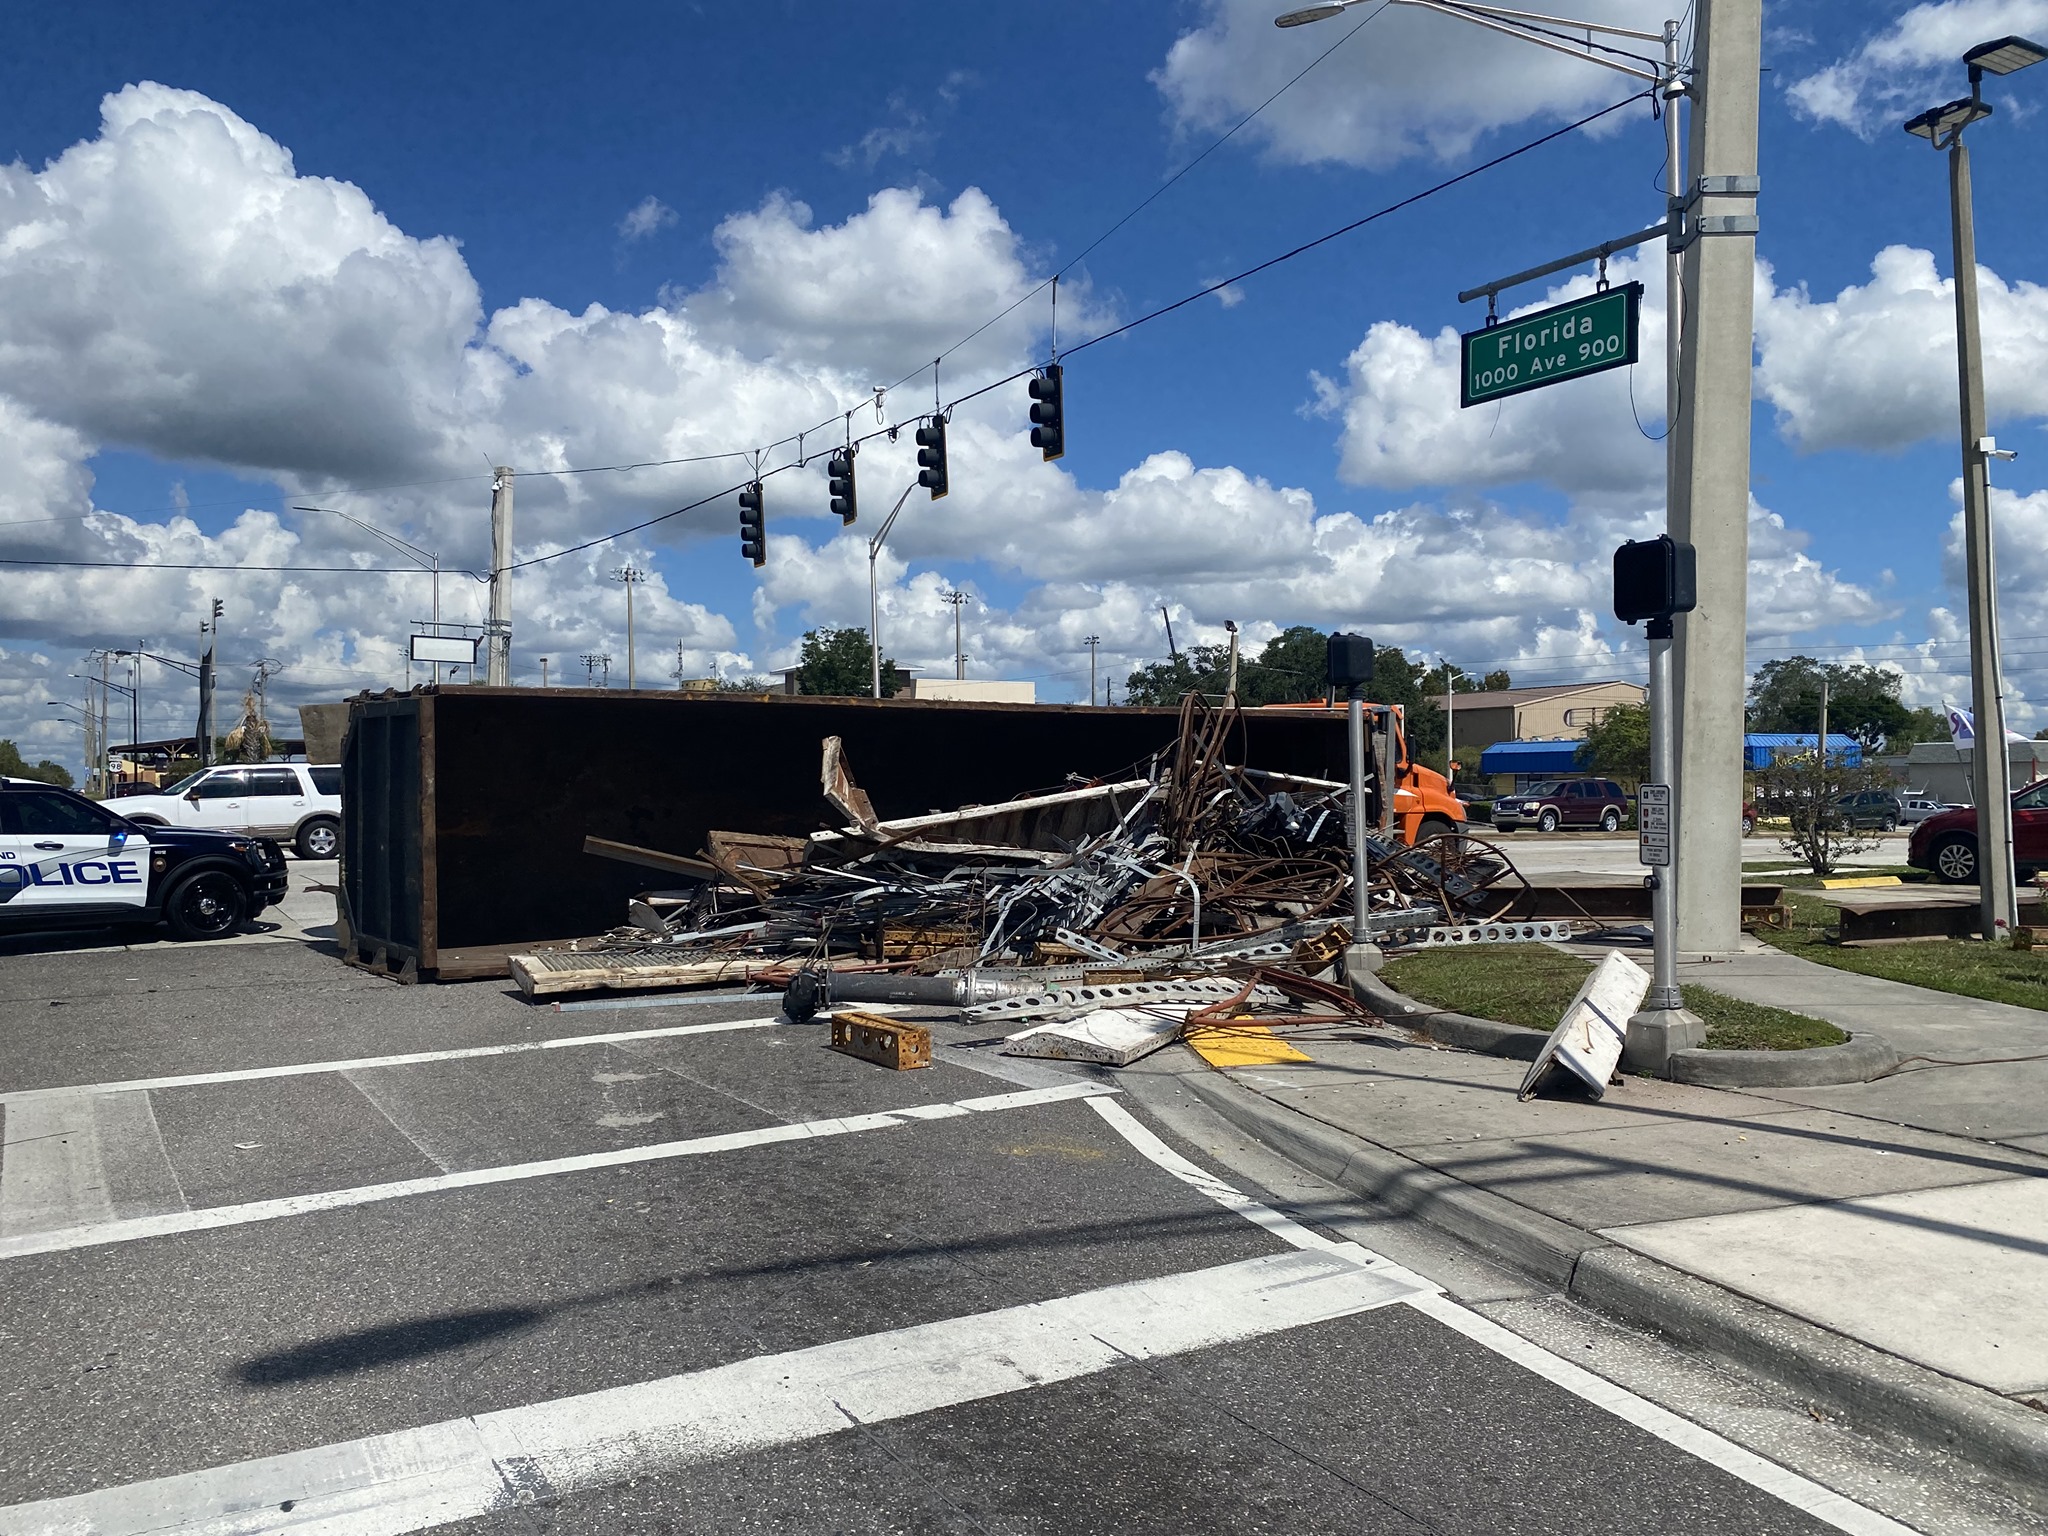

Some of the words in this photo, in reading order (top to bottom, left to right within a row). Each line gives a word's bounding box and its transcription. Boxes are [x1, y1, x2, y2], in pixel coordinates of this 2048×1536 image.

[1498, 315, 1593, 358] Florida
[1474, 363, 1518, 389] 1000
[1530, 353, 1567, 375] Ave
[1578, 334, 1620, 361] 900
[111, 763, 122, 771] 98
